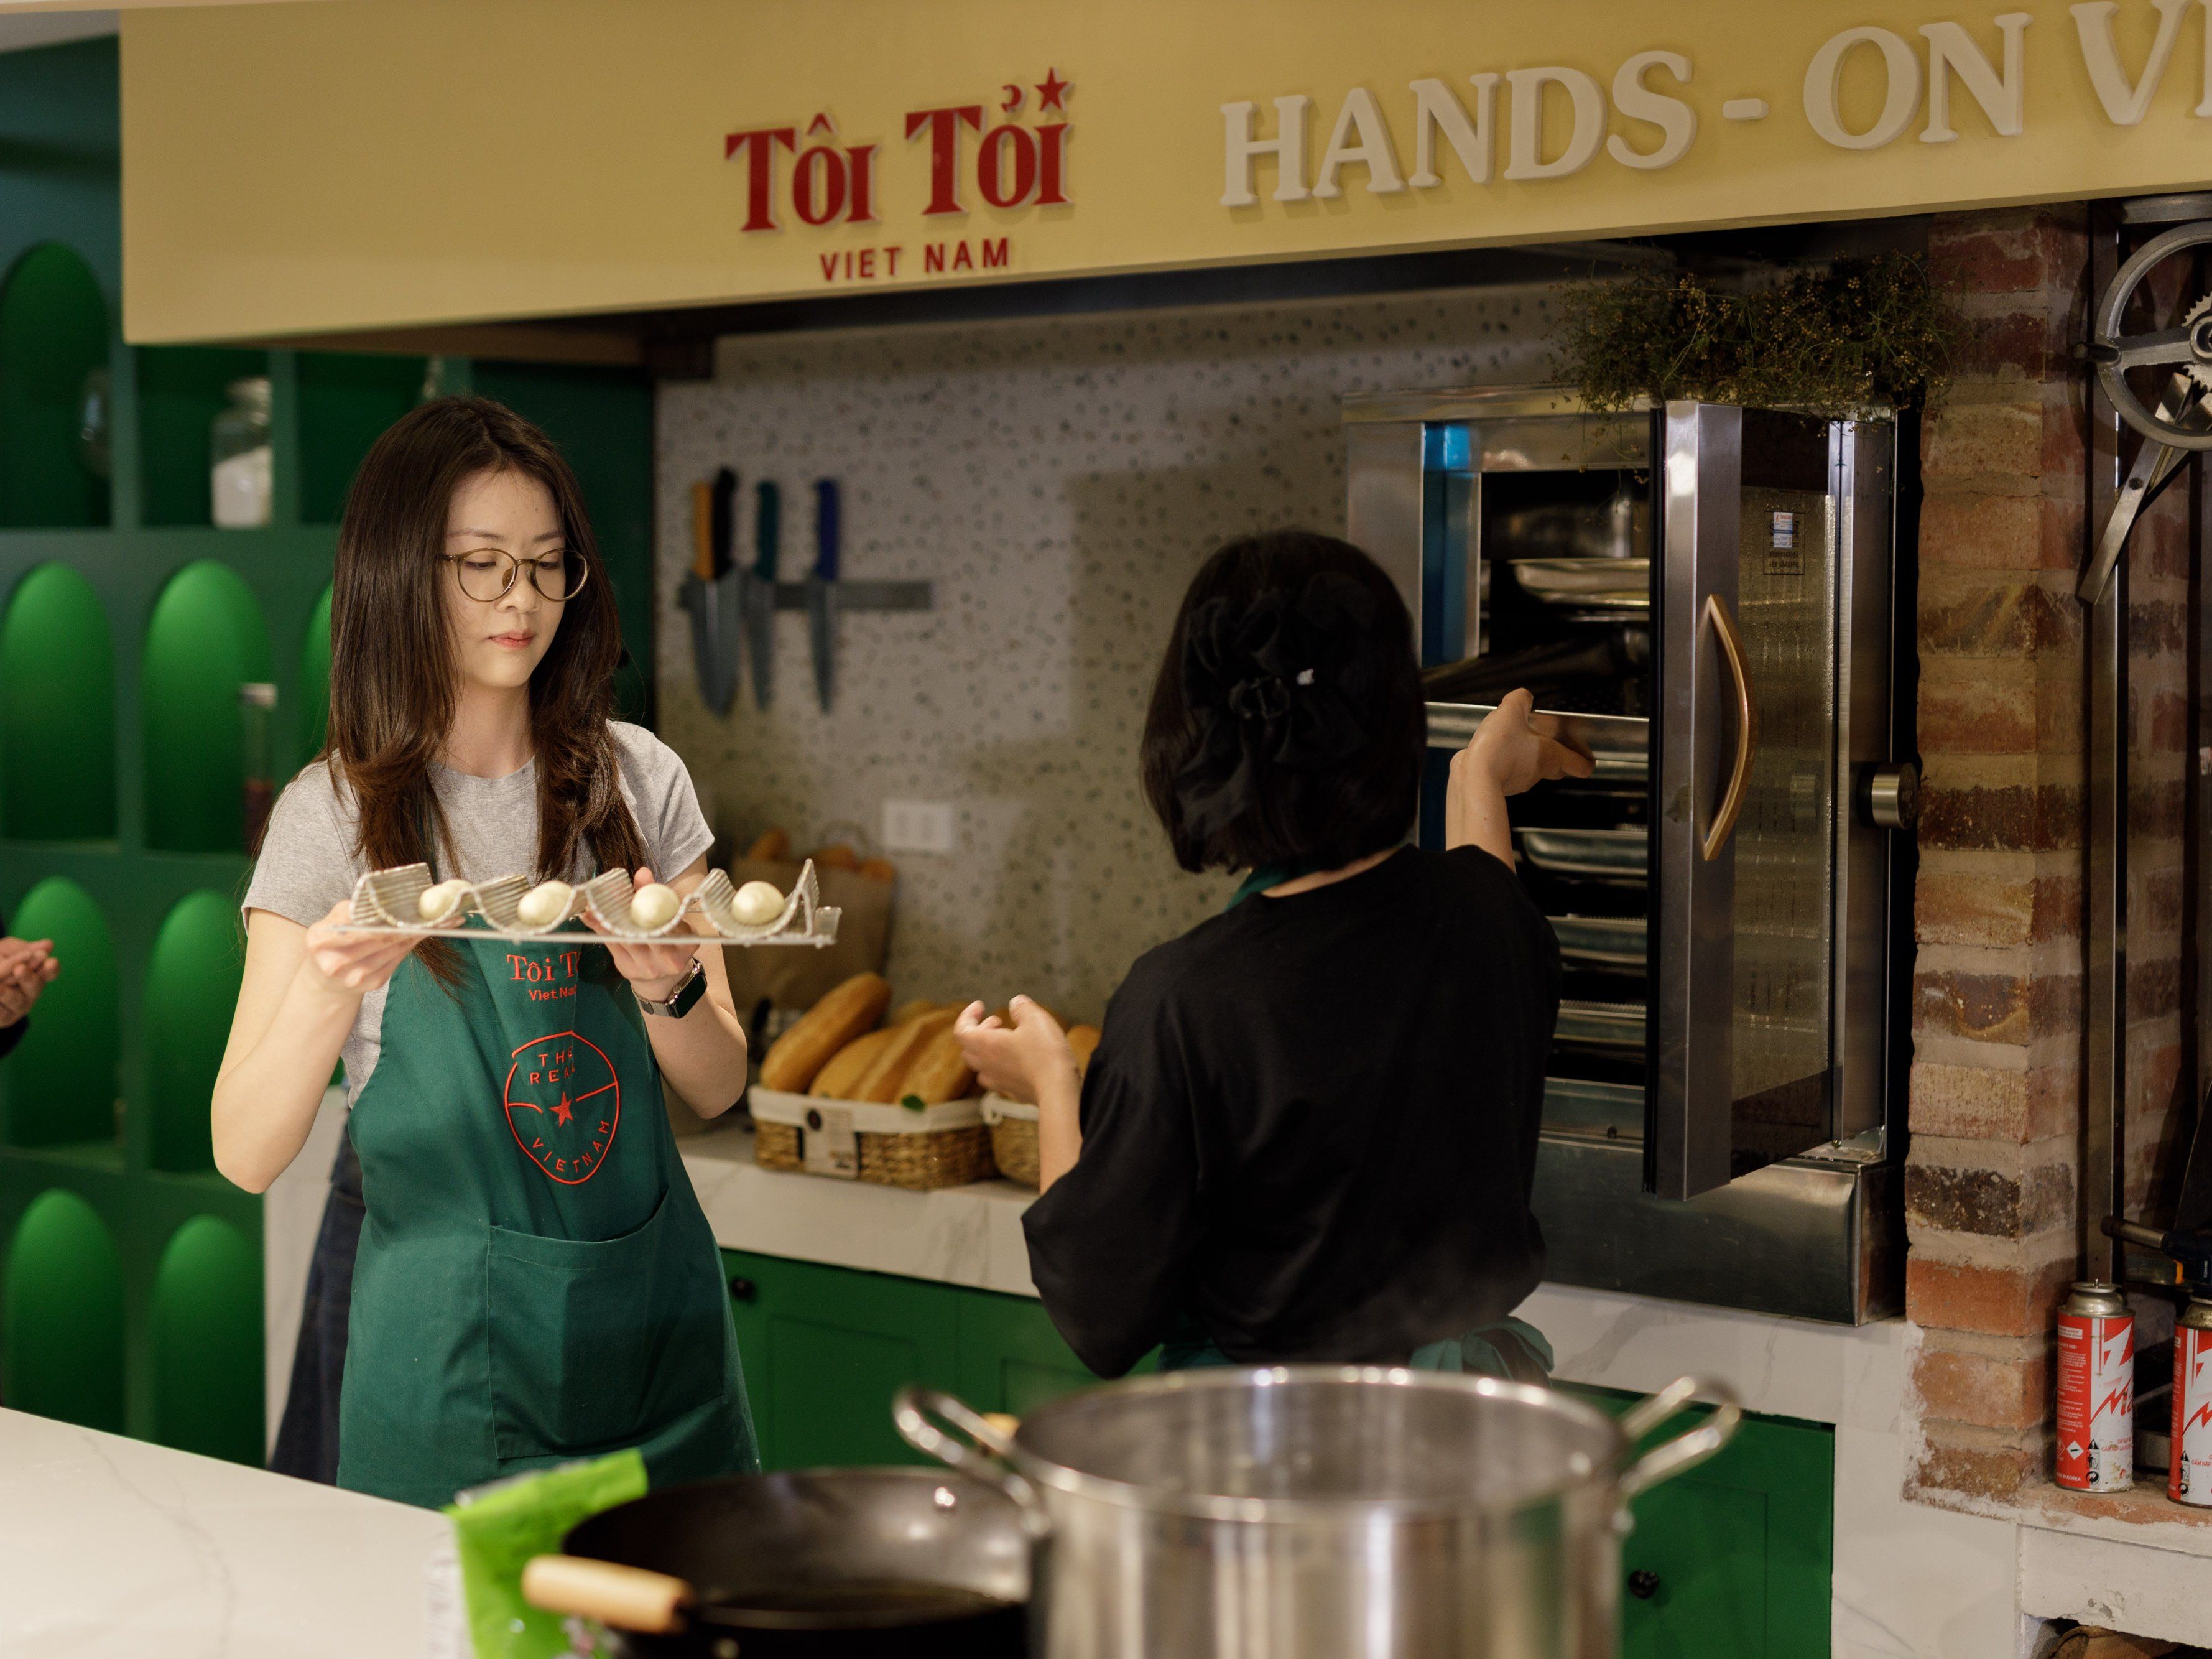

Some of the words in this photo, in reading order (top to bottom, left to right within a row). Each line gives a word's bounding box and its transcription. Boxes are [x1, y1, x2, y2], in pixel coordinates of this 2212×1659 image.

[1220, 50, 1697, 206] HANDS
[1803, 12, 2033, 150] ON
[820, 246, 902, 282] VIET
[925, 237, 1011, 274] NAM
[506, 954, 555, 982] Tôi
[560, 951, 582, 978] T
[532, 1120, 610, 1173] VIETNAM
